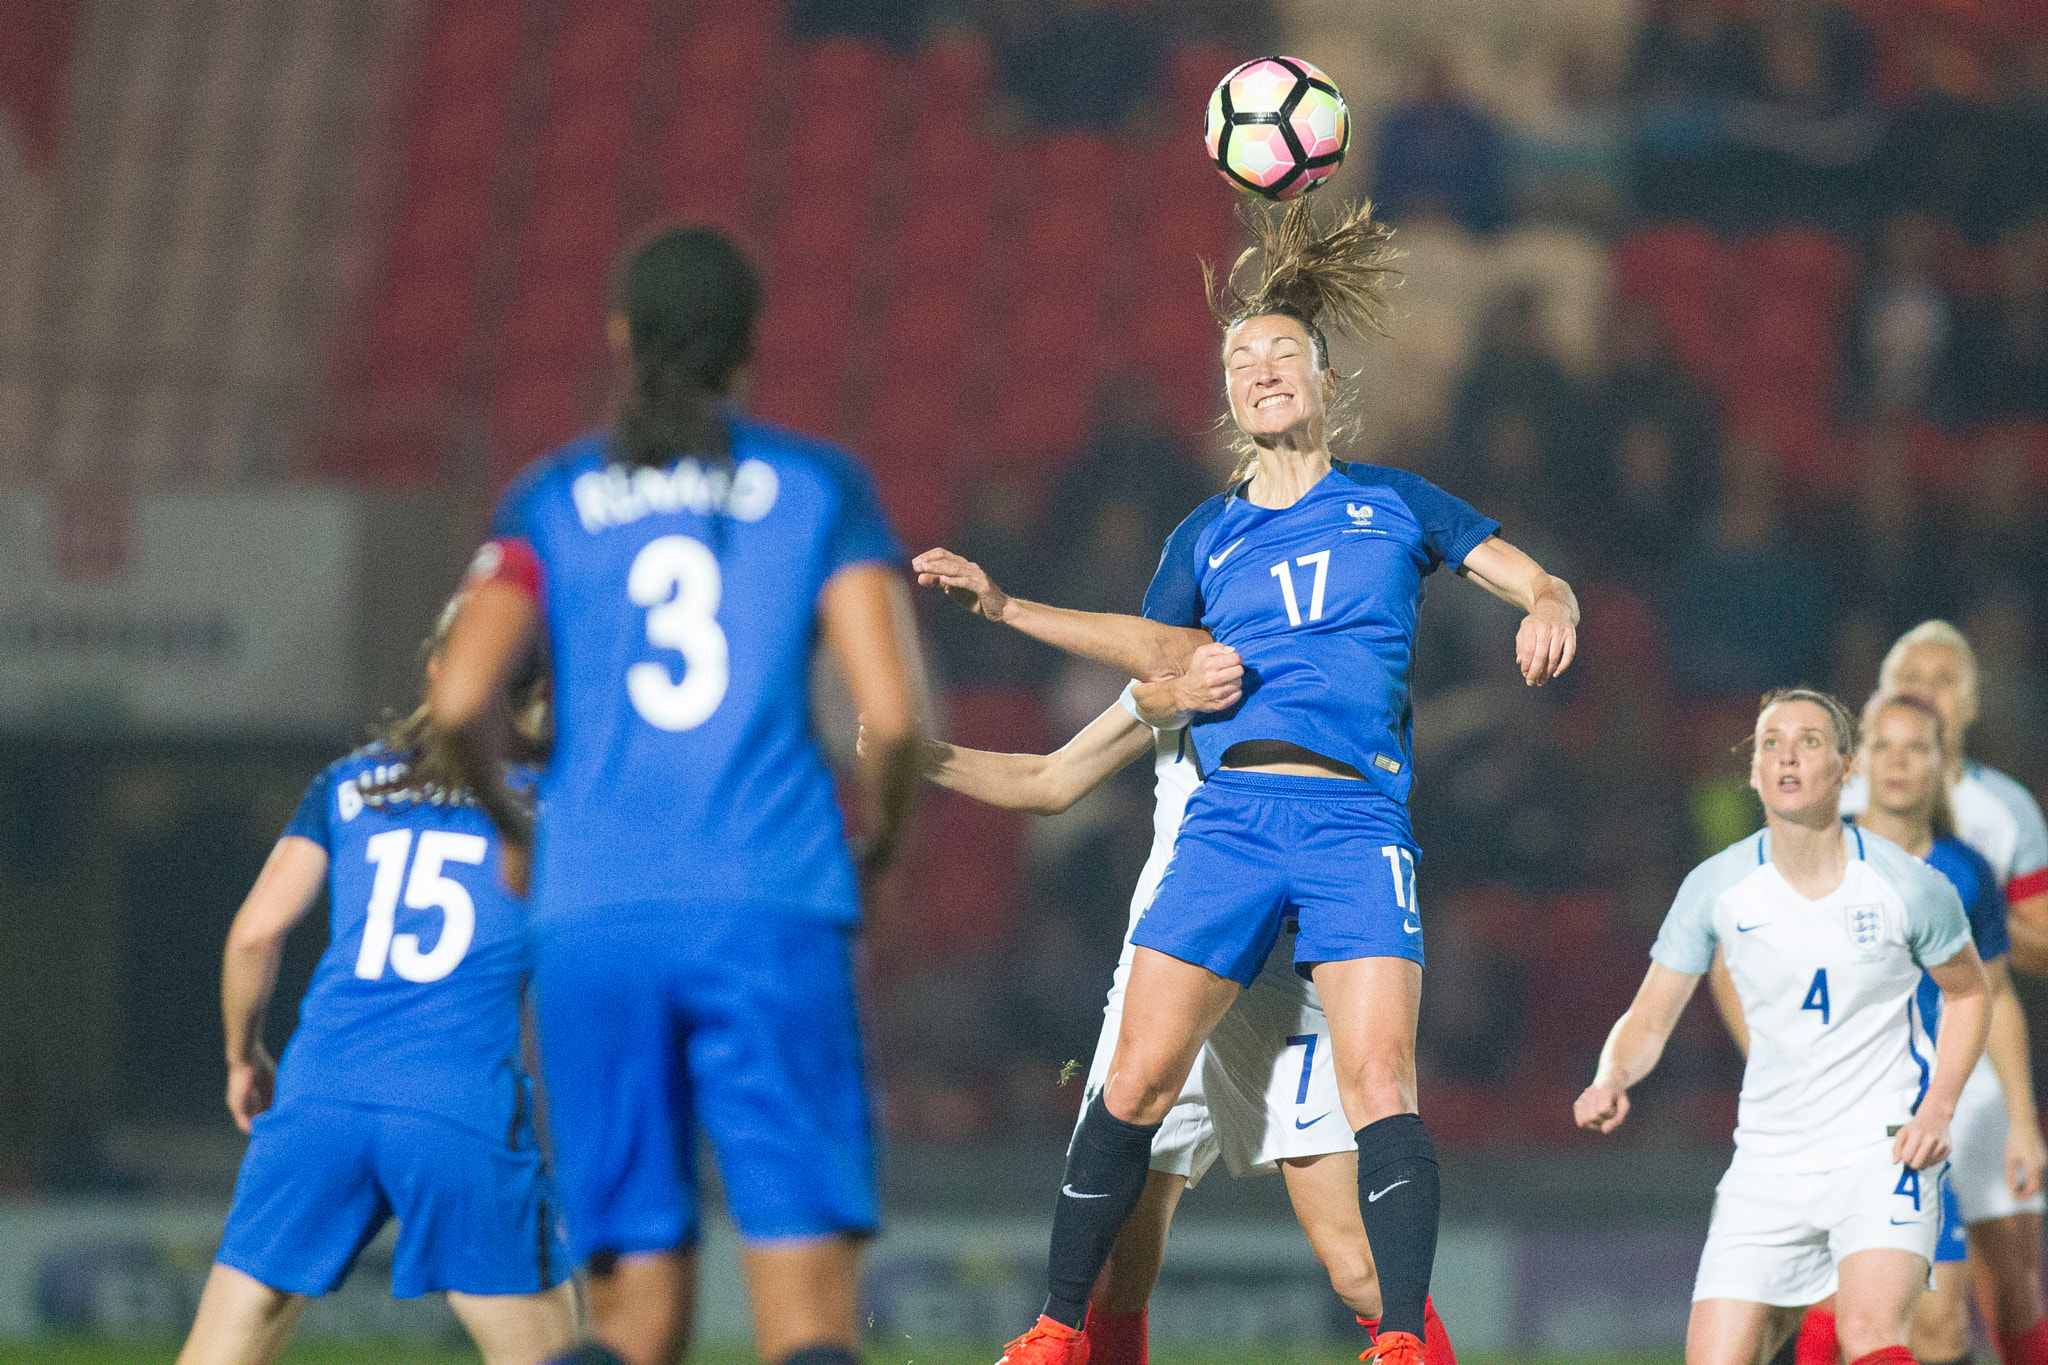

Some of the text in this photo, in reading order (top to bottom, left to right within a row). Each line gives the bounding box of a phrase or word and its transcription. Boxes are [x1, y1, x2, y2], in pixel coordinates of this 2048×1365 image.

[1270, 550, 1330, 626] 17
[627, 535, 729, 731] 3
[355, 828, 487, 983] 15
[1382, 845, 1416, 914] 17
[1801, 967, 1830, 1025] 4
[1286, 1033, 1318, 1104] 7
[1893, 1163, 1920, 1211] 4
